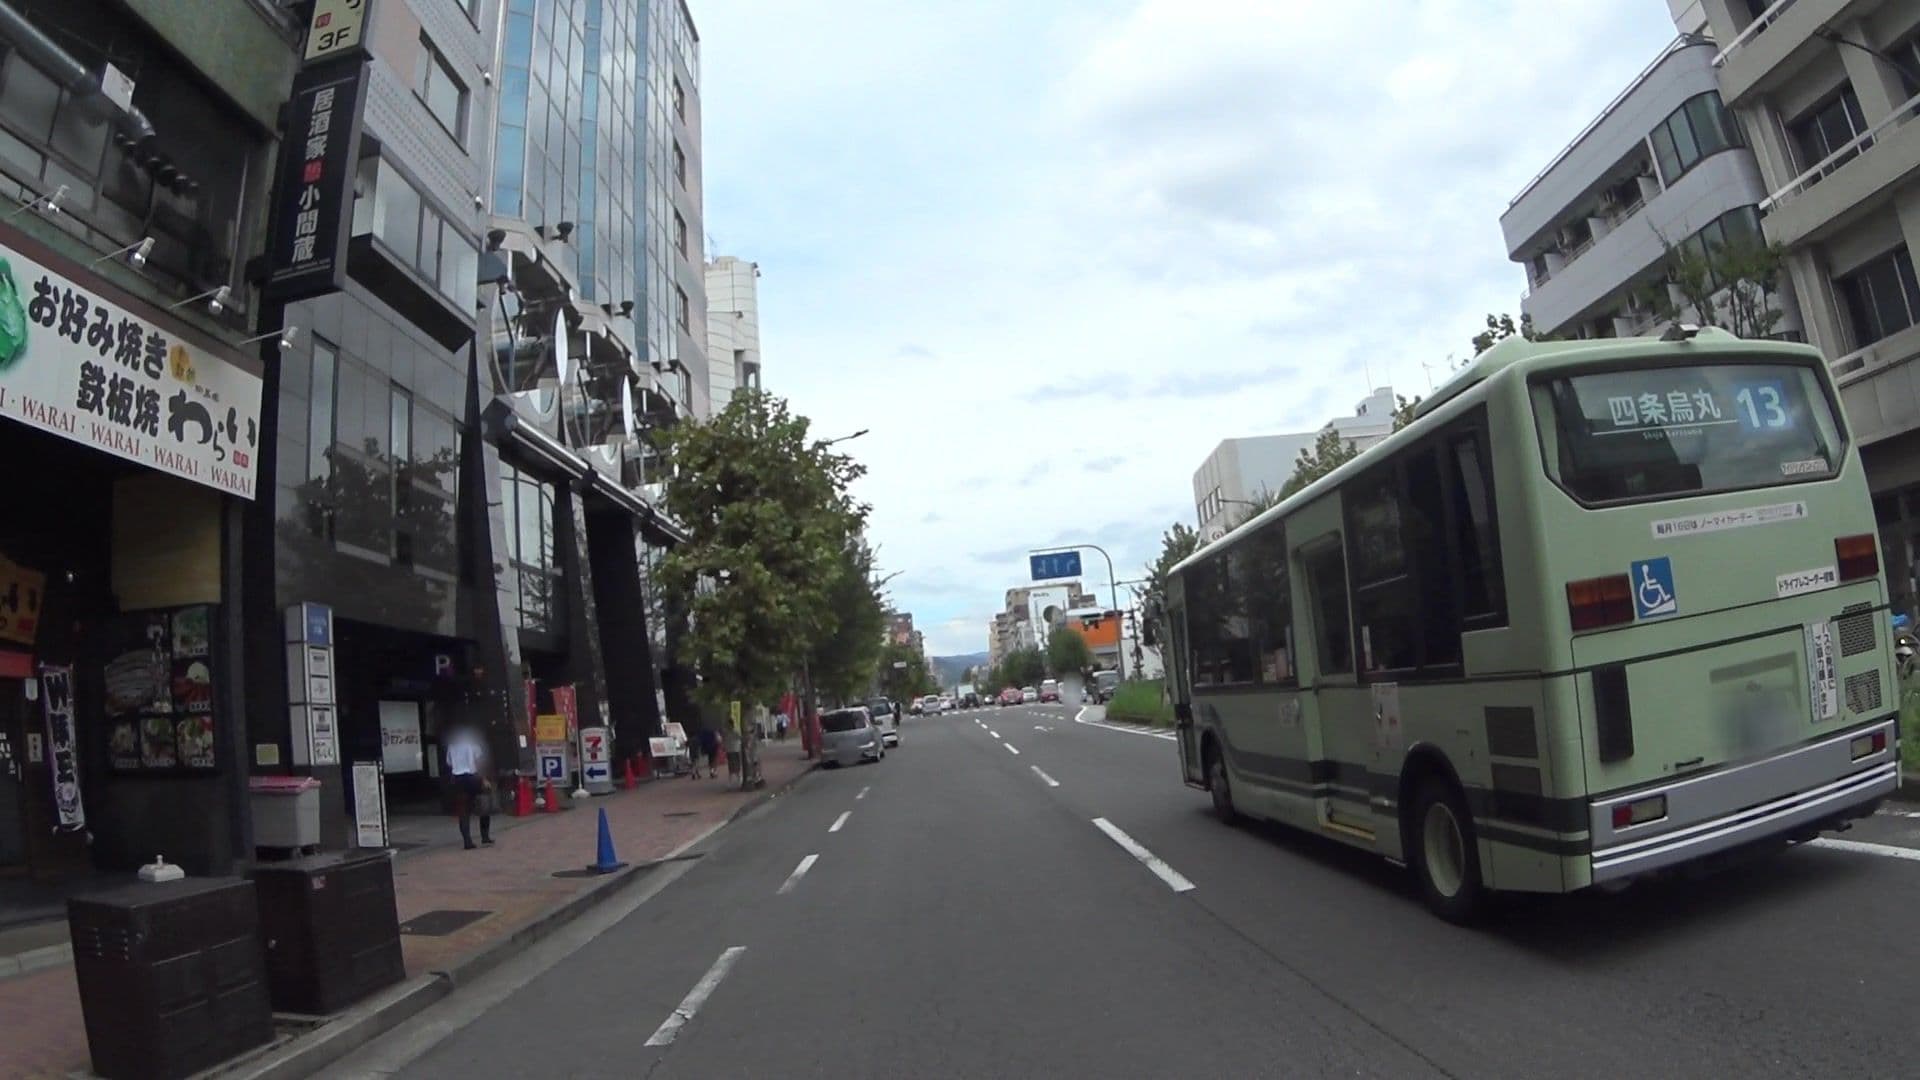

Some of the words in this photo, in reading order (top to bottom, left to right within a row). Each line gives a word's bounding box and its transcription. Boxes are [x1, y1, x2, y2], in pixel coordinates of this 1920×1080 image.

[317, 26, 351, 51] 3F
[28, 275, 168, 380] お好み焼き
[76, 361, 161, 437] 鉄板焼
[168, 389, 256, 461] わらい
[1607, 388, 1721, 426] 四条烏丸
[1736, 385, 1787, 429] 13
[22, 396, 76, 433] WARAI
[91, 422, 141, 457] WARAI
[154, 445, 199, 476] WARAI
[211, 465, 251, 494] WARAI
[435, 656, 450, 676] P
[545, 759, 558, 775] P
